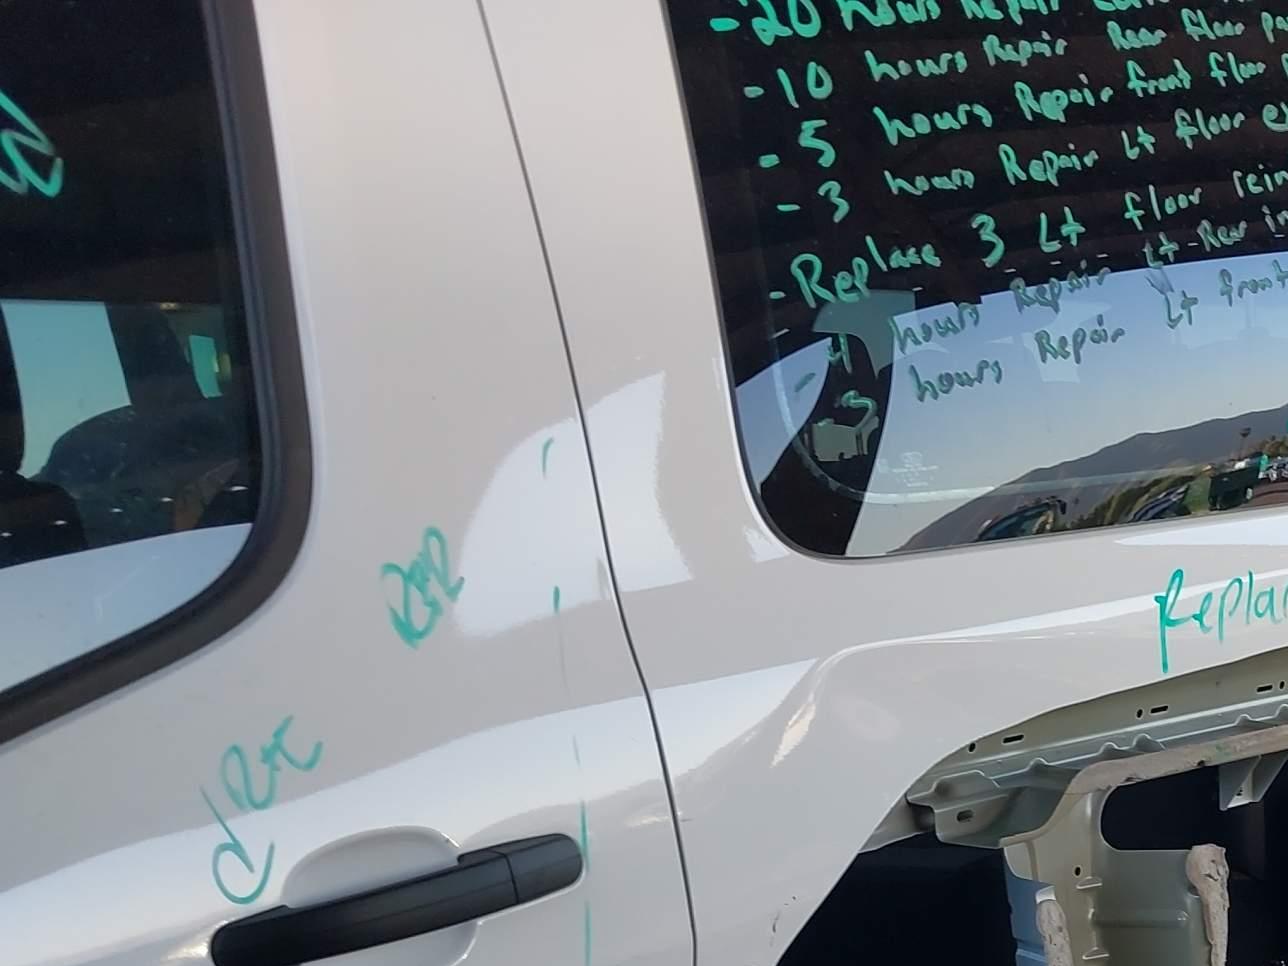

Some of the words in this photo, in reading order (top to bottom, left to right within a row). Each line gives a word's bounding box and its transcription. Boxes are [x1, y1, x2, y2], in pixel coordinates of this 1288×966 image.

[864, 50, 966, 82] hours
[982, 34, 1068, 67] Repair
[1107, 21, 1167, 50] Rear
[1181, 8, 1245, 42] floor
[873, 103, 993, 146] hours
[1014, 73, 1114, 122] Repair
[1128, 60, 1192, 97] front
[1209, 51, 1266, 88] floor
[885, 168, 975, 196] hours
[999, 143, 1099, 187] Repair
[1121, 125, 1156, 160] Lt
[1174, 107, 1246, 150] floor
[970, 212, 1005, 268] 3
[1038, 206, 1086, 253] Lt
[1123, 184, 1202, 231] floor
[889, 302, 980, 354] hours
[1010, 259, 1111, 313] Repair
[1197, 219, 1247, 252] Rear
[909, 359, 1002, 402] hours
[1035, 313, 1125, 364] Repair
